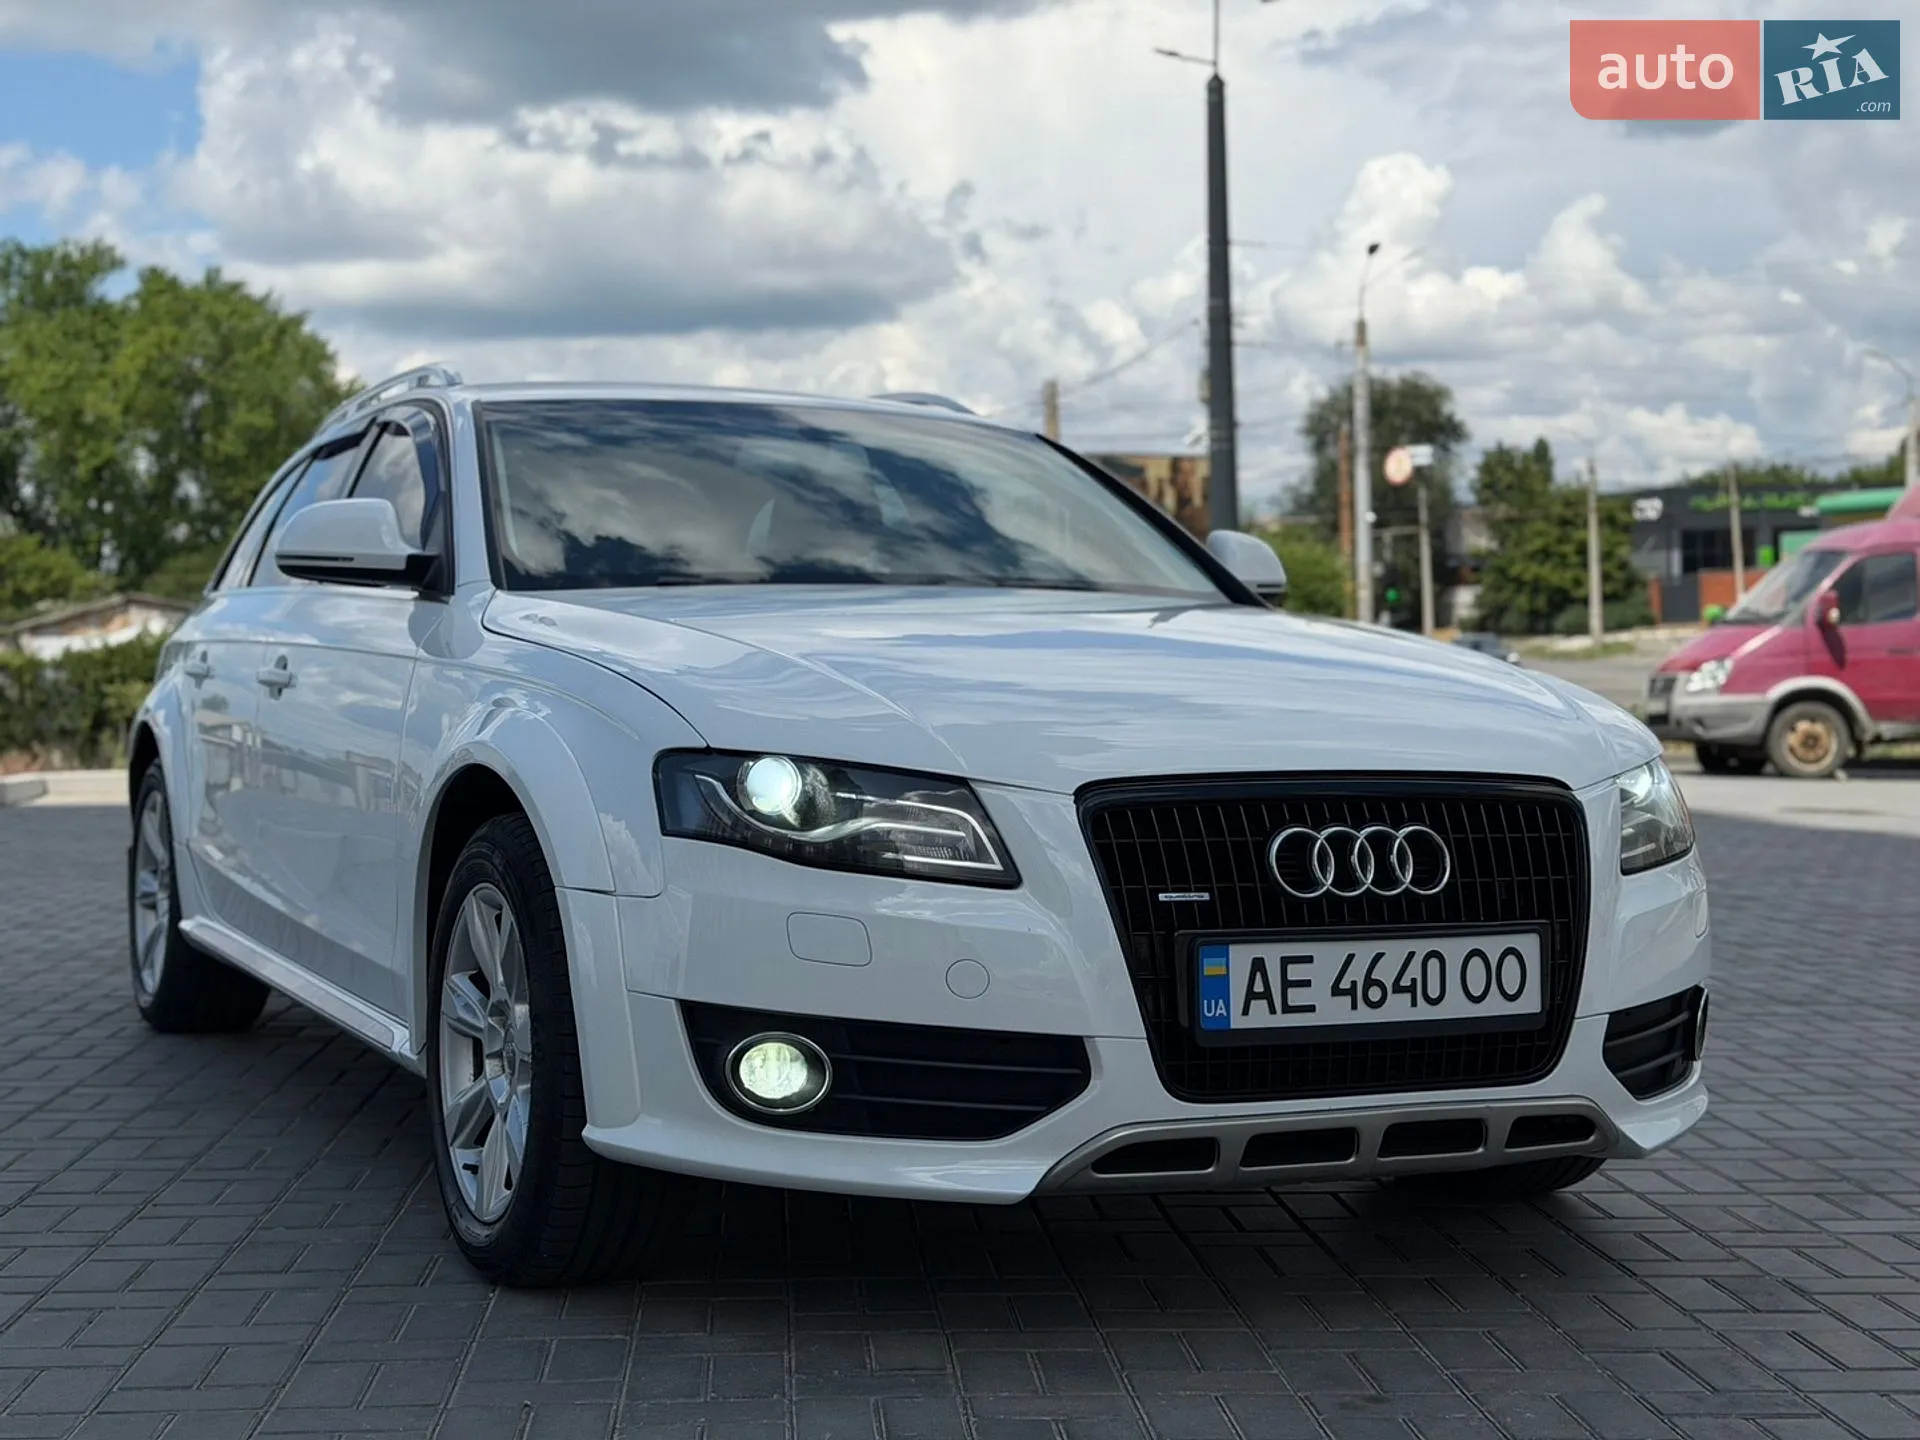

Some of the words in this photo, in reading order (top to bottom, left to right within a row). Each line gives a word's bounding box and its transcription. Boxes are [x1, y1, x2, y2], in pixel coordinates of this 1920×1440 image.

[1240, 954, 1317, 1017] AE
[1330, 949, 1447, 1011] 4640
[1460, 945, 1527, 1005] OO
[1203, 999, 1228, 1017] UA
